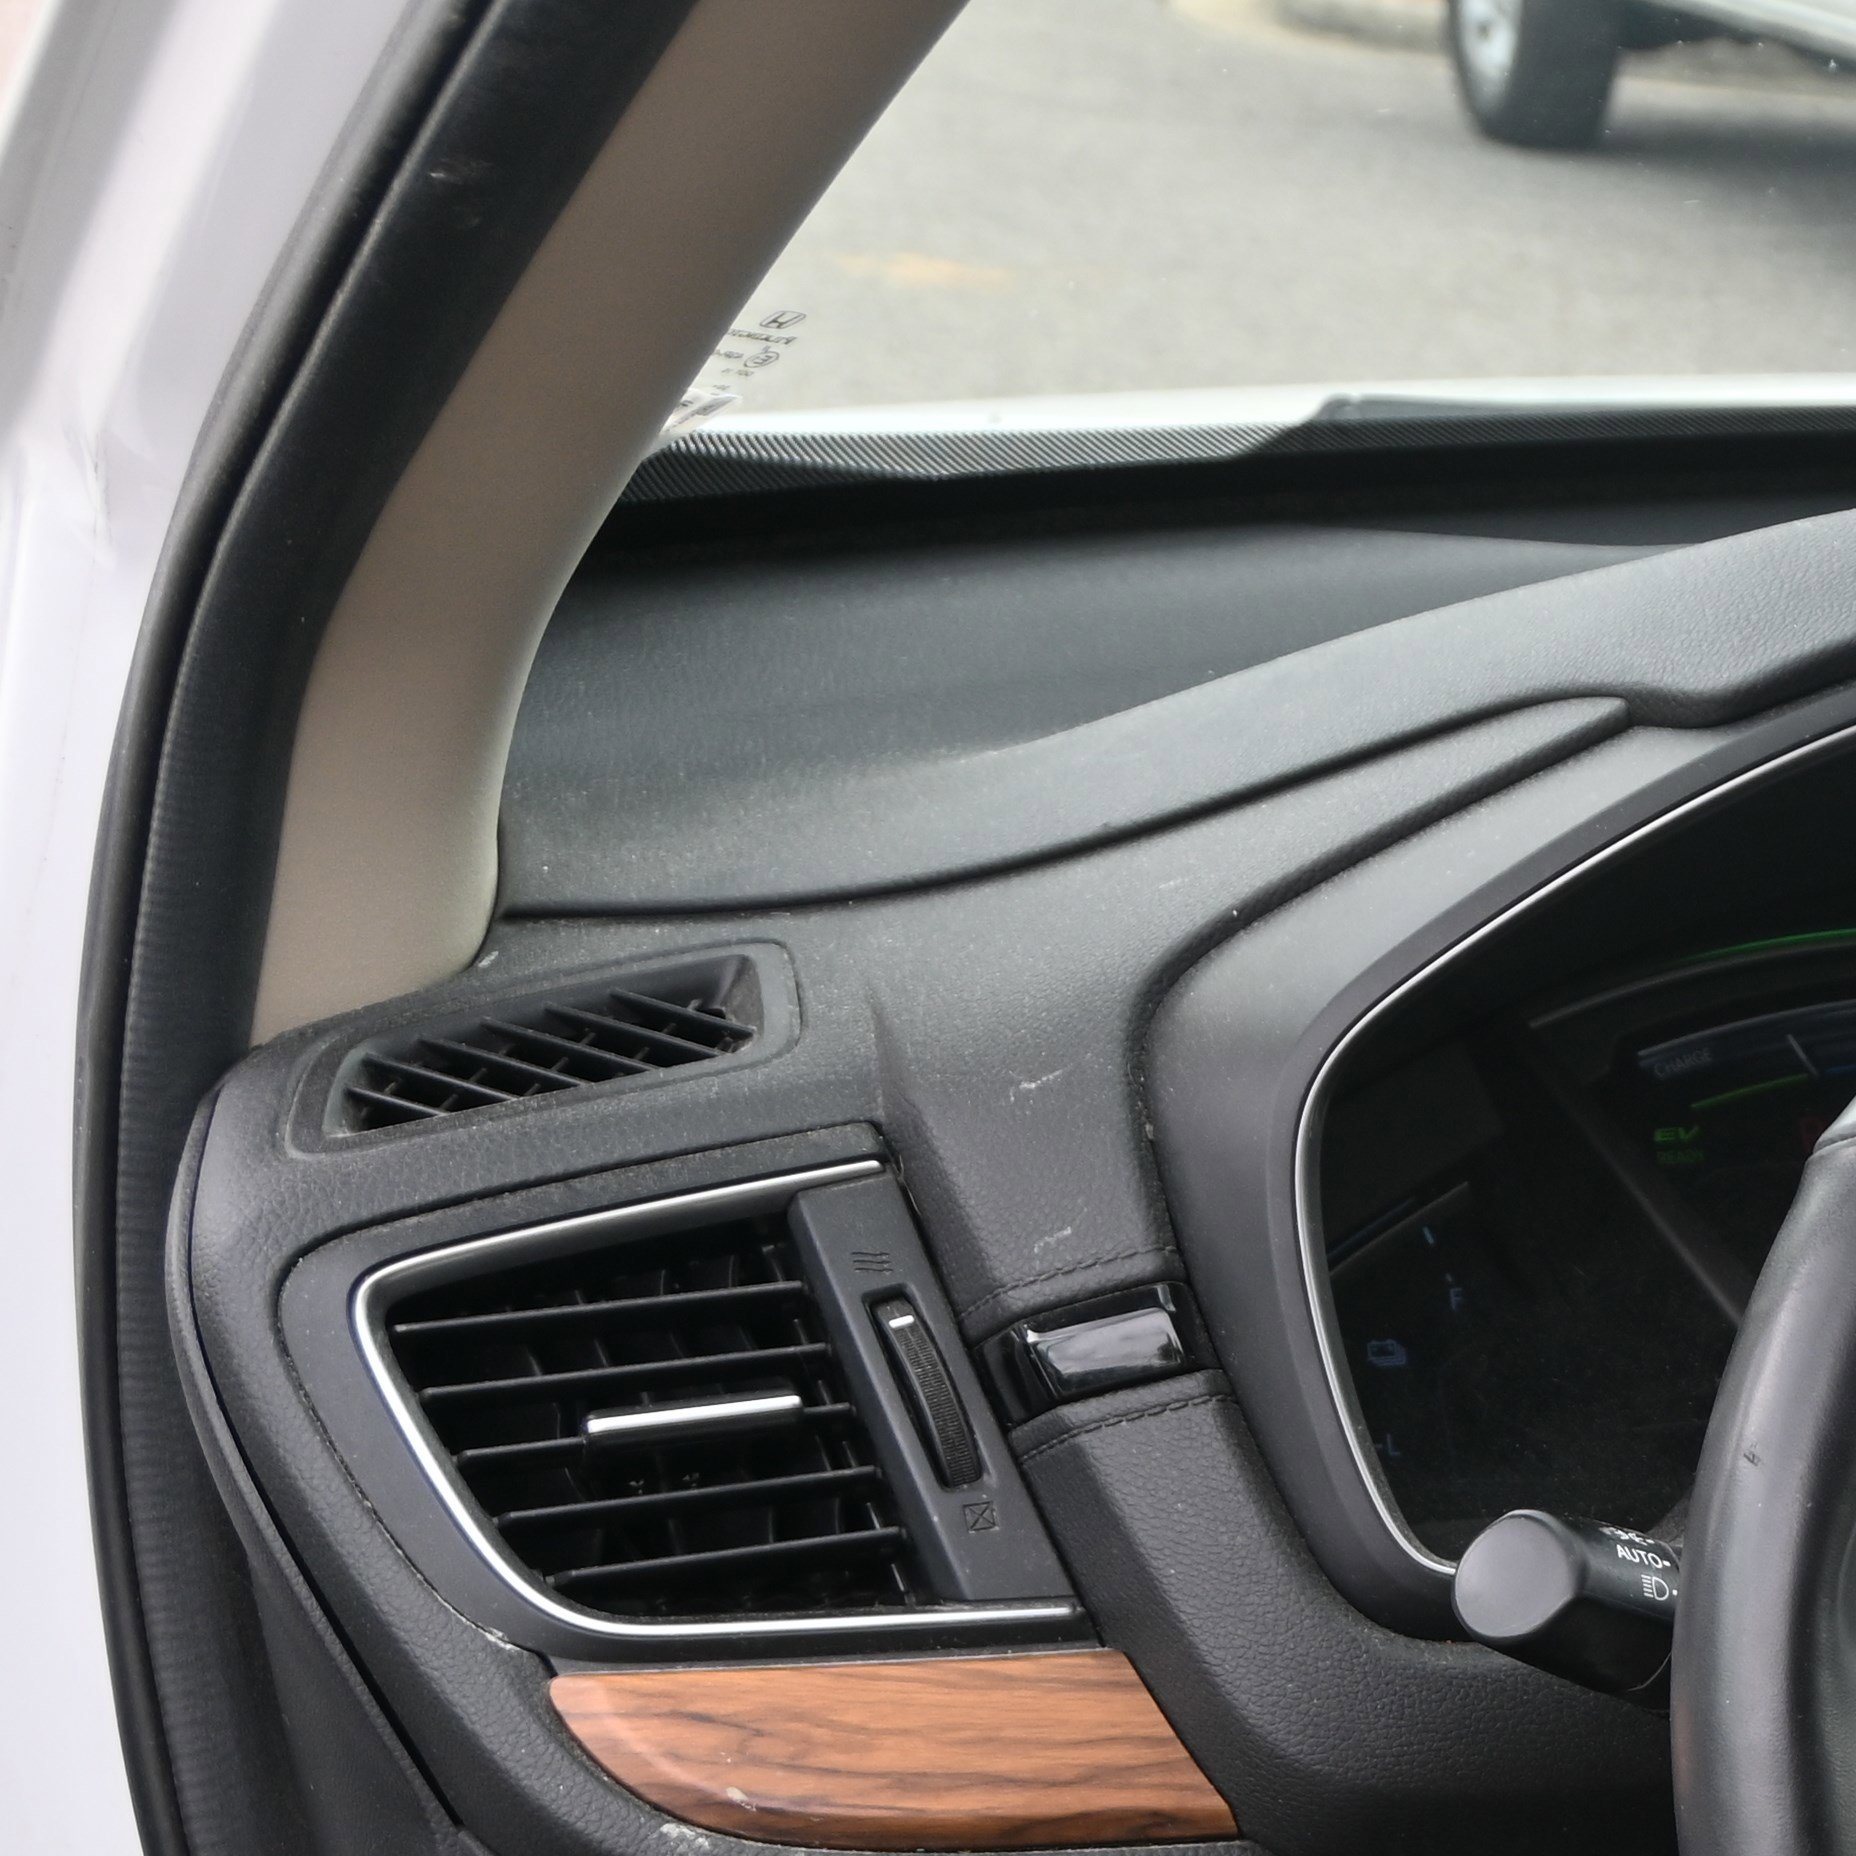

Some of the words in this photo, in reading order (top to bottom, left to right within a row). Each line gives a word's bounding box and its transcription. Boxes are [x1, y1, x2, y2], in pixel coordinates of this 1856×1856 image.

[1653, 1049, 1714, 1081] CHARGE
[1653, 1125, 1700, 1144] EV
[1616, 1544, 1663, 1569] AUTO
